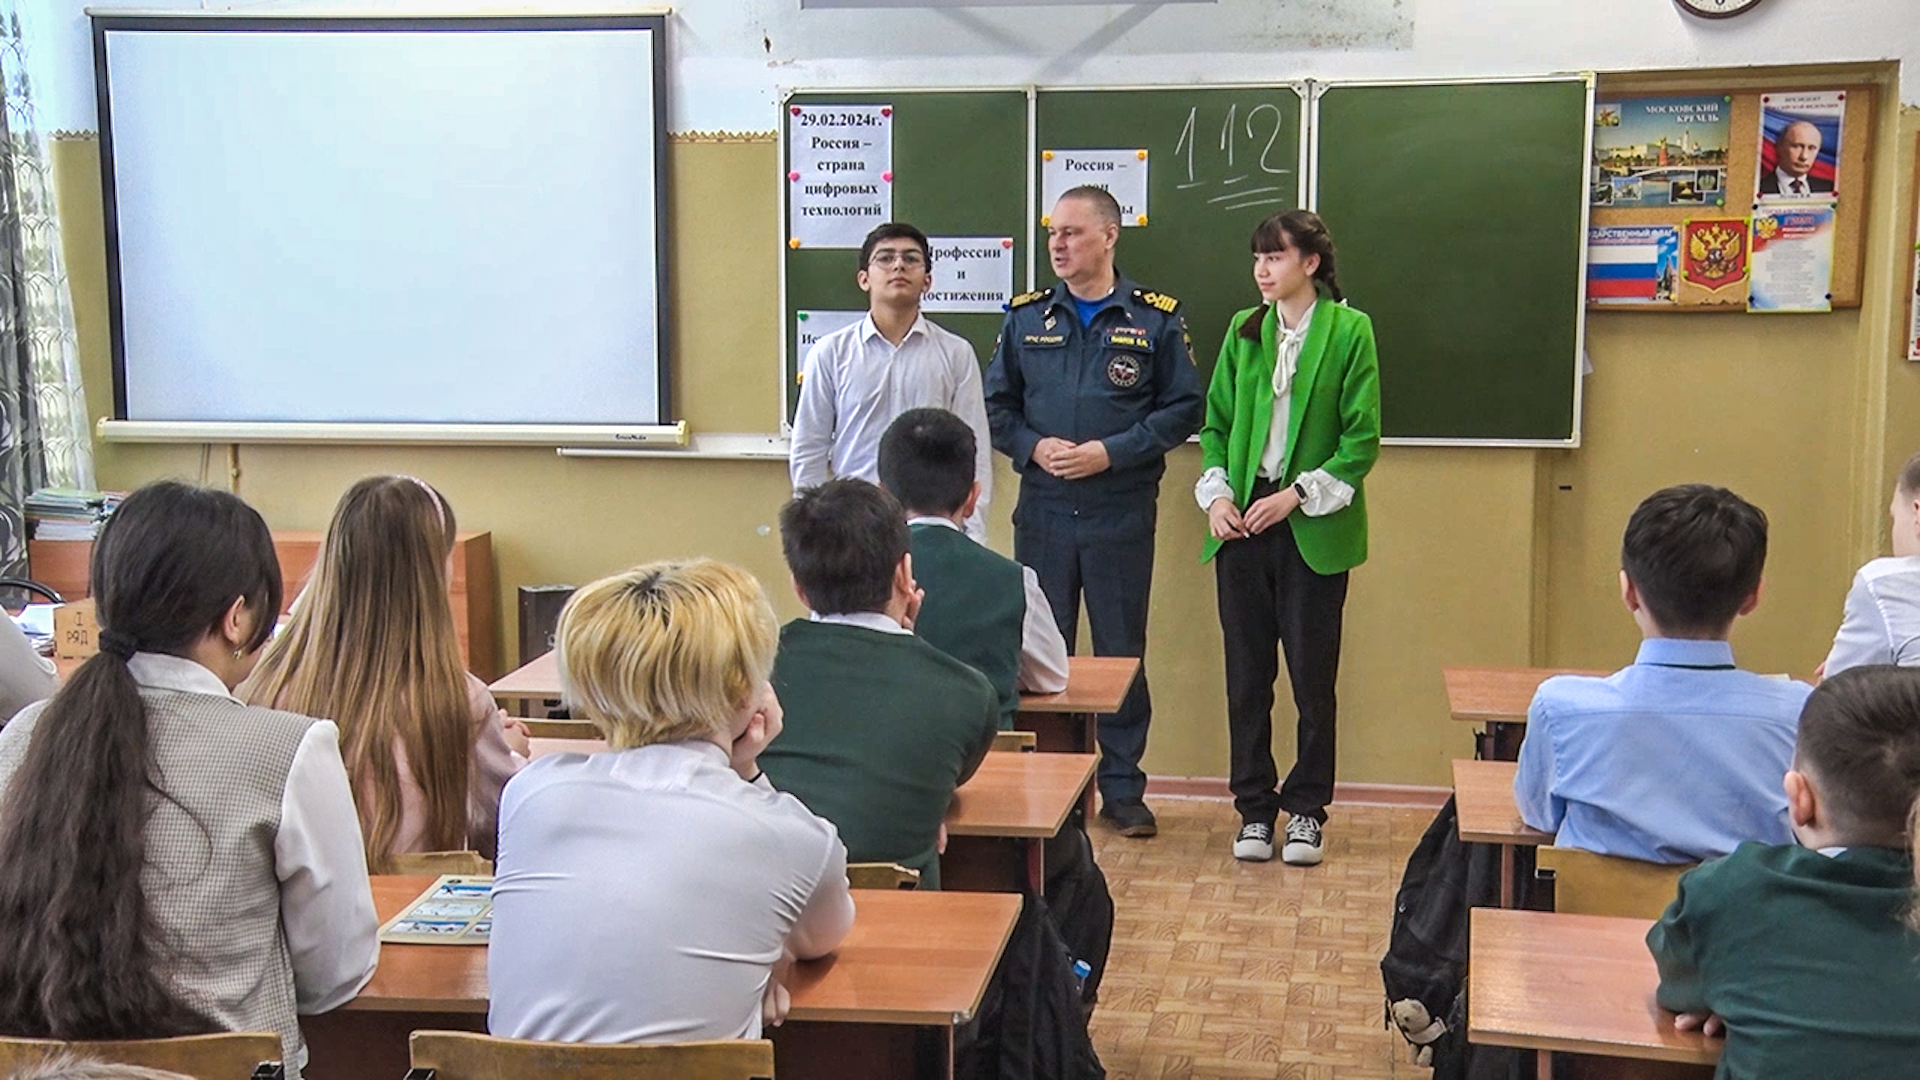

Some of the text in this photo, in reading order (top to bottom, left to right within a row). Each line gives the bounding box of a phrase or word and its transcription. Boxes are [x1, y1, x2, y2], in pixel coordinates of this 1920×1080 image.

[1646, 102, 1719, 114] МОСКОВСКИЙ
[801, 113, 882, 126] 29.02.2024г.
[1676, 113, 1720, 123] КРЕМЛЬ
[811, 136, 860, 149] Россия
[1174, 103, 1292, 182] 112
[817, 161, 865, 174] страна
[1065, 158, 1114, 171] Россия
[804, 181, 878, 198] цифровых
[801, 202, 882, 217] технологий
[957, 271, 965, 279] и
[66, 630, 88, 645] РЯД
